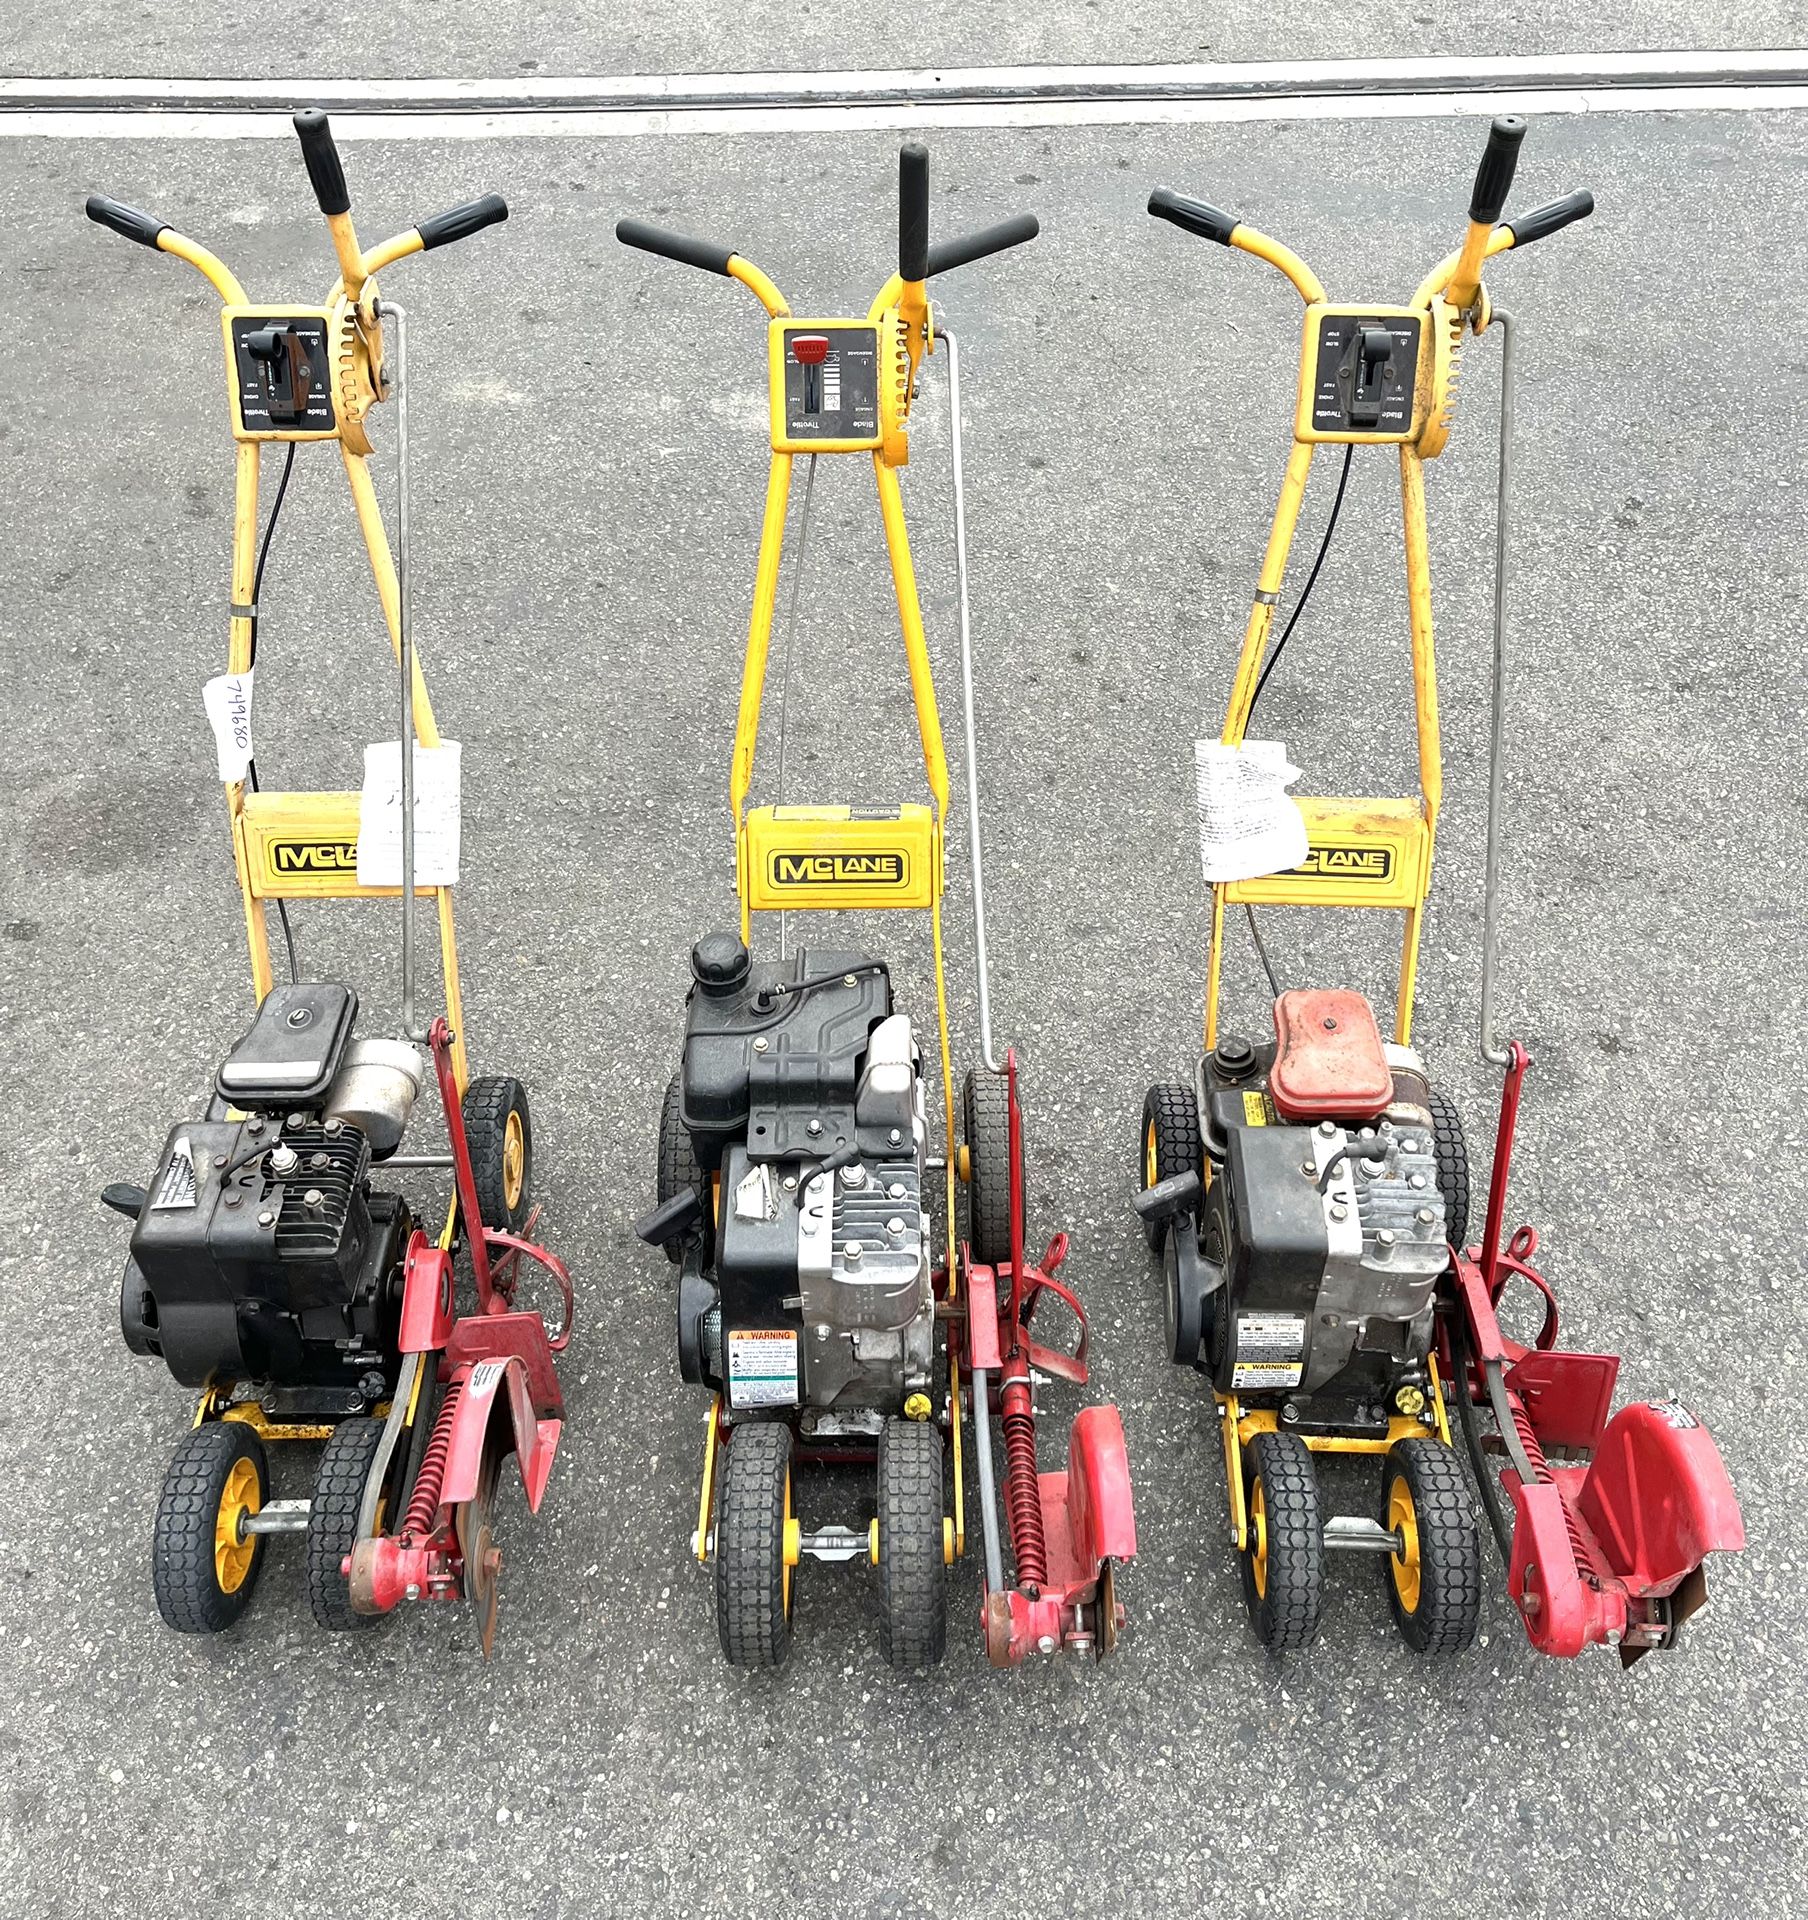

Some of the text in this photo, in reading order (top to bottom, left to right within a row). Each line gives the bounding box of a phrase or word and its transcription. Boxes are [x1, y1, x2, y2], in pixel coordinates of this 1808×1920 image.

[1316, 410, 1342, 418] Throttle
[1382, 411, 1403, 419] Blade
[226, 680, 248, 749] 749680
[279, 845, 358, 869] MCLA
[1298, 850, 1385, 875] CLANE
[751, 1331, 790, 1340] WARNING
